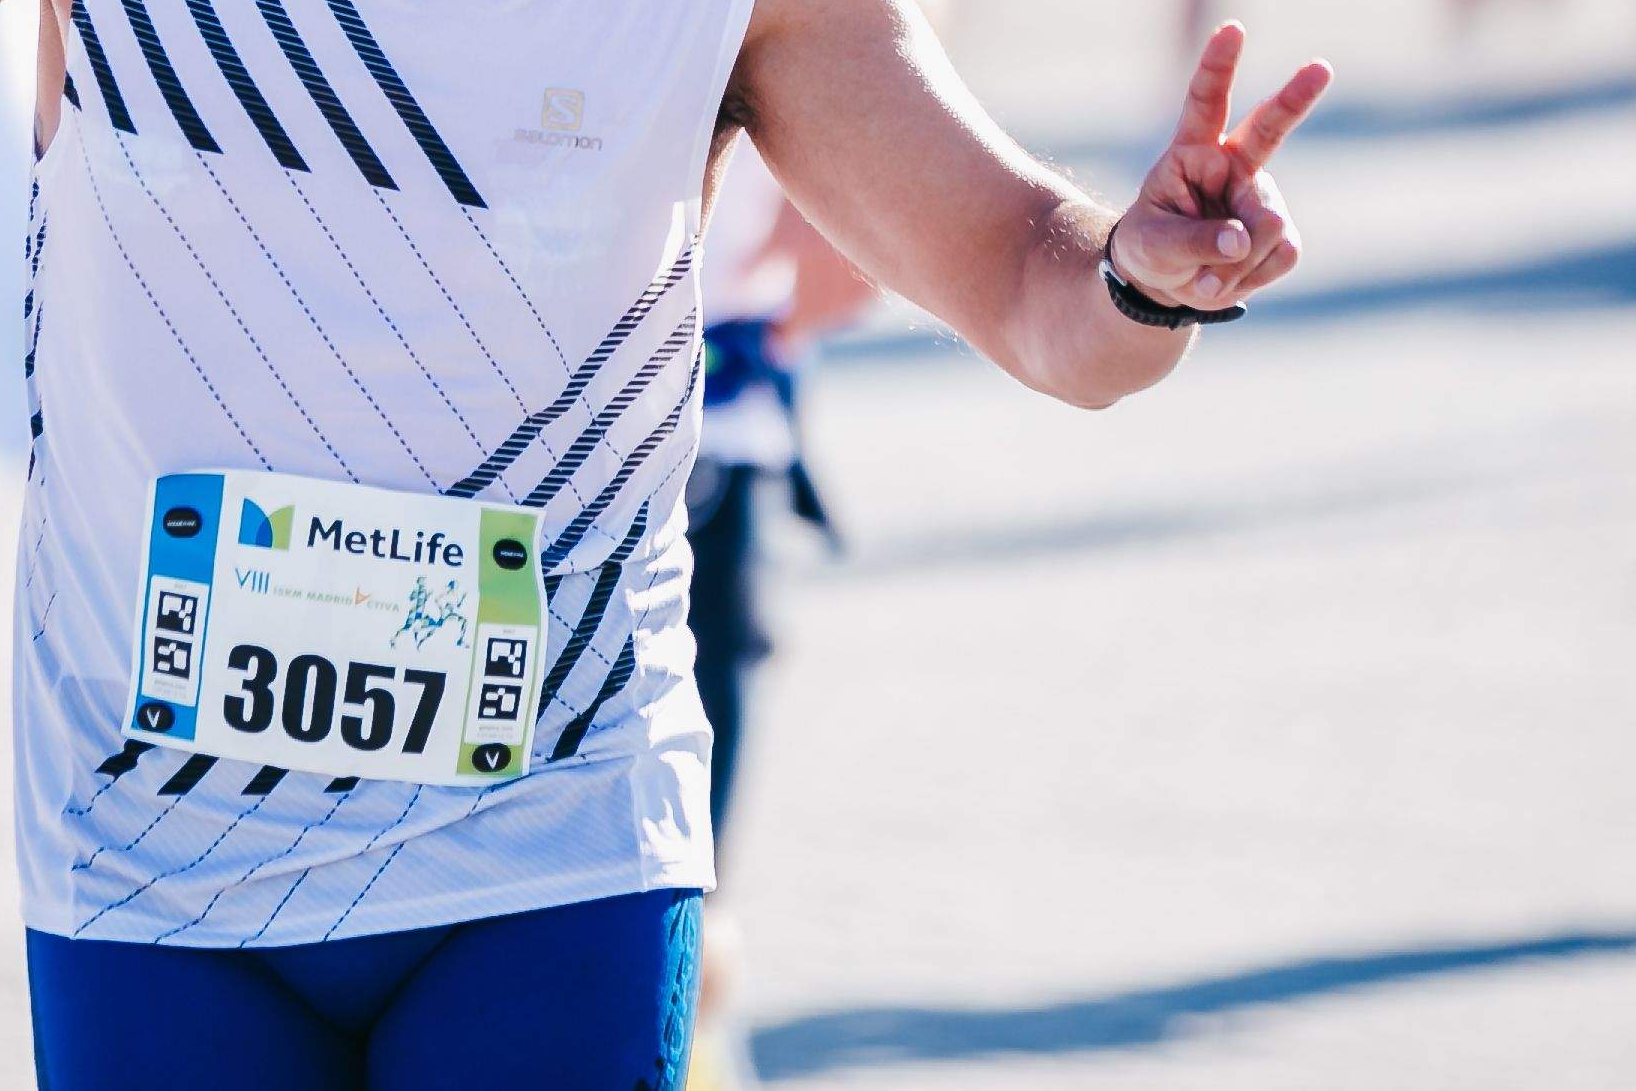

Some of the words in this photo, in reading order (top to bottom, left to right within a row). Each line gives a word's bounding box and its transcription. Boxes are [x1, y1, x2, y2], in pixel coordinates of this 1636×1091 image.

[307, 516, 464, 567] MetLife
[235, 566, 270, 594] VIII
[306, 591, 354, 605] MADRID
[223, 644, 447, 755] 3057
